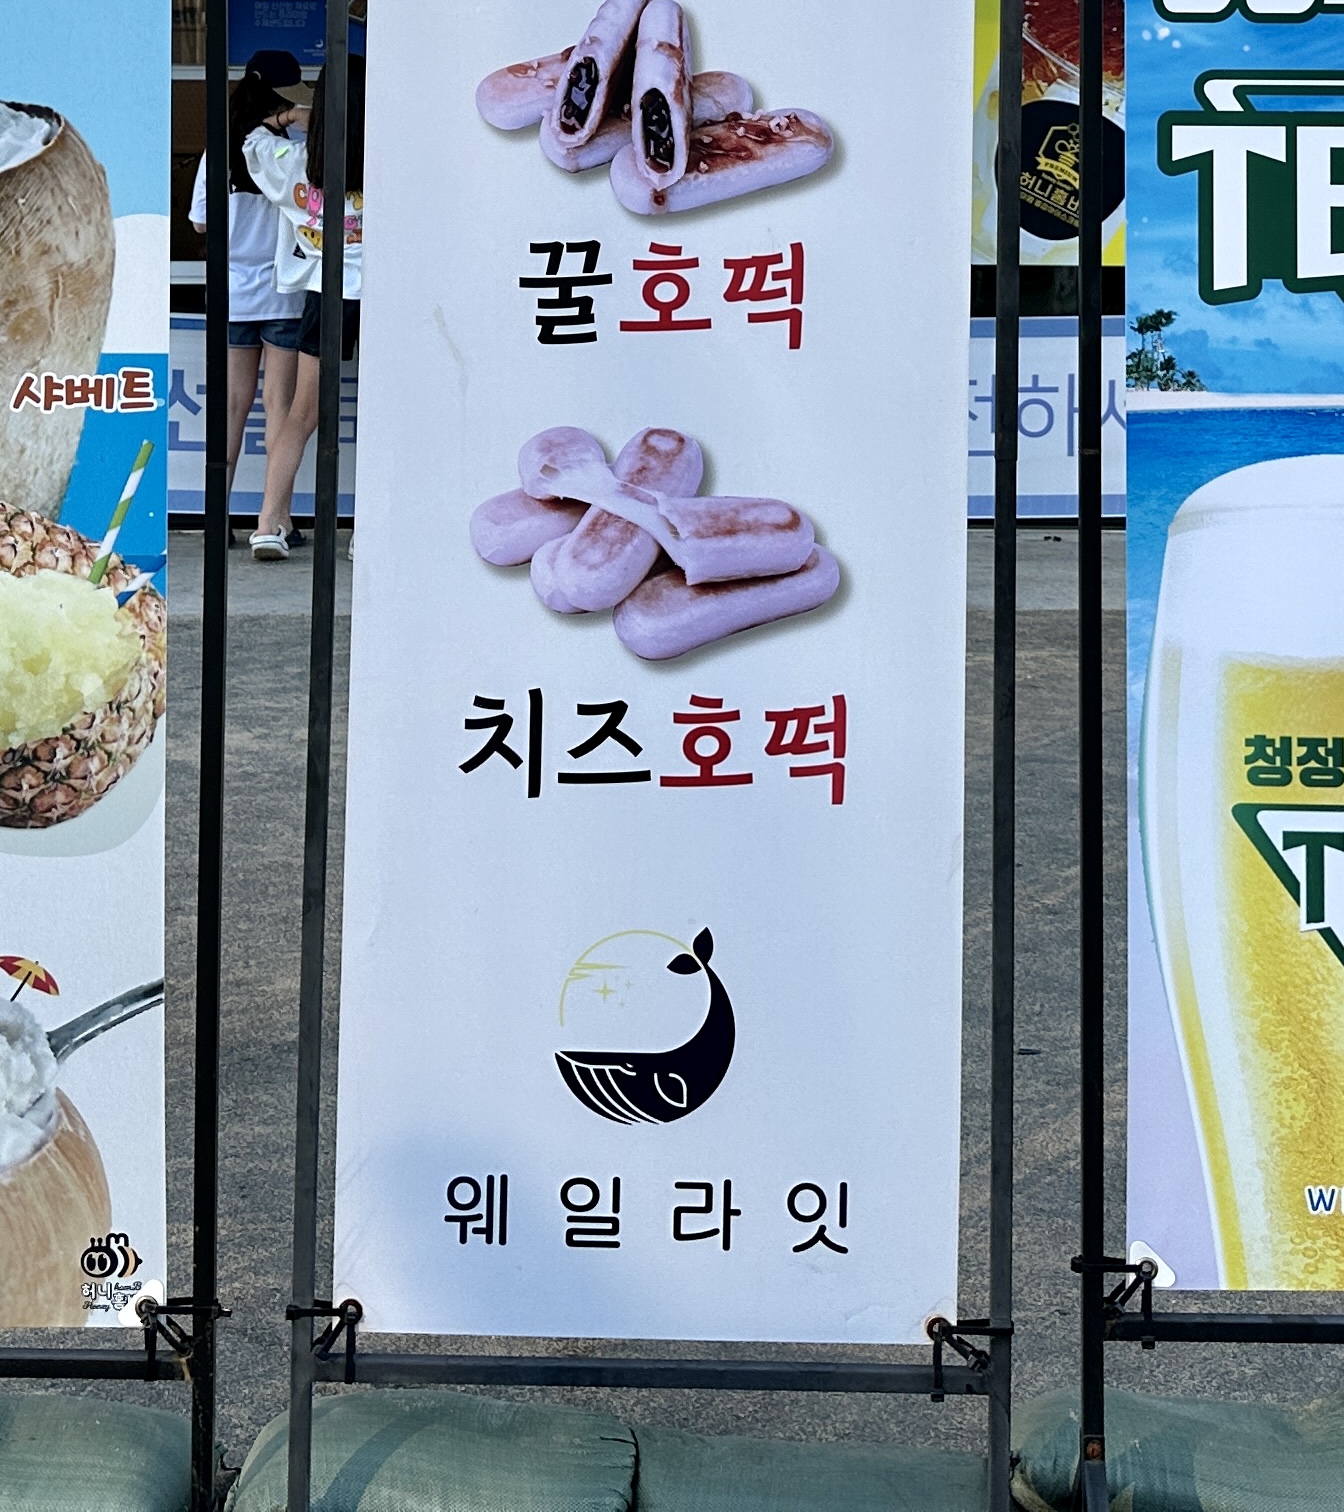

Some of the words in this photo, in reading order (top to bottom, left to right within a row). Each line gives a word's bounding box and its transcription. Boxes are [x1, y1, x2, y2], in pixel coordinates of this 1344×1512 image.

[11, 368, 158, 412] 샤베트
[444, 1173, 849, 1255] 웨일라잇
[81, 1282, 112, 1300] 허니
